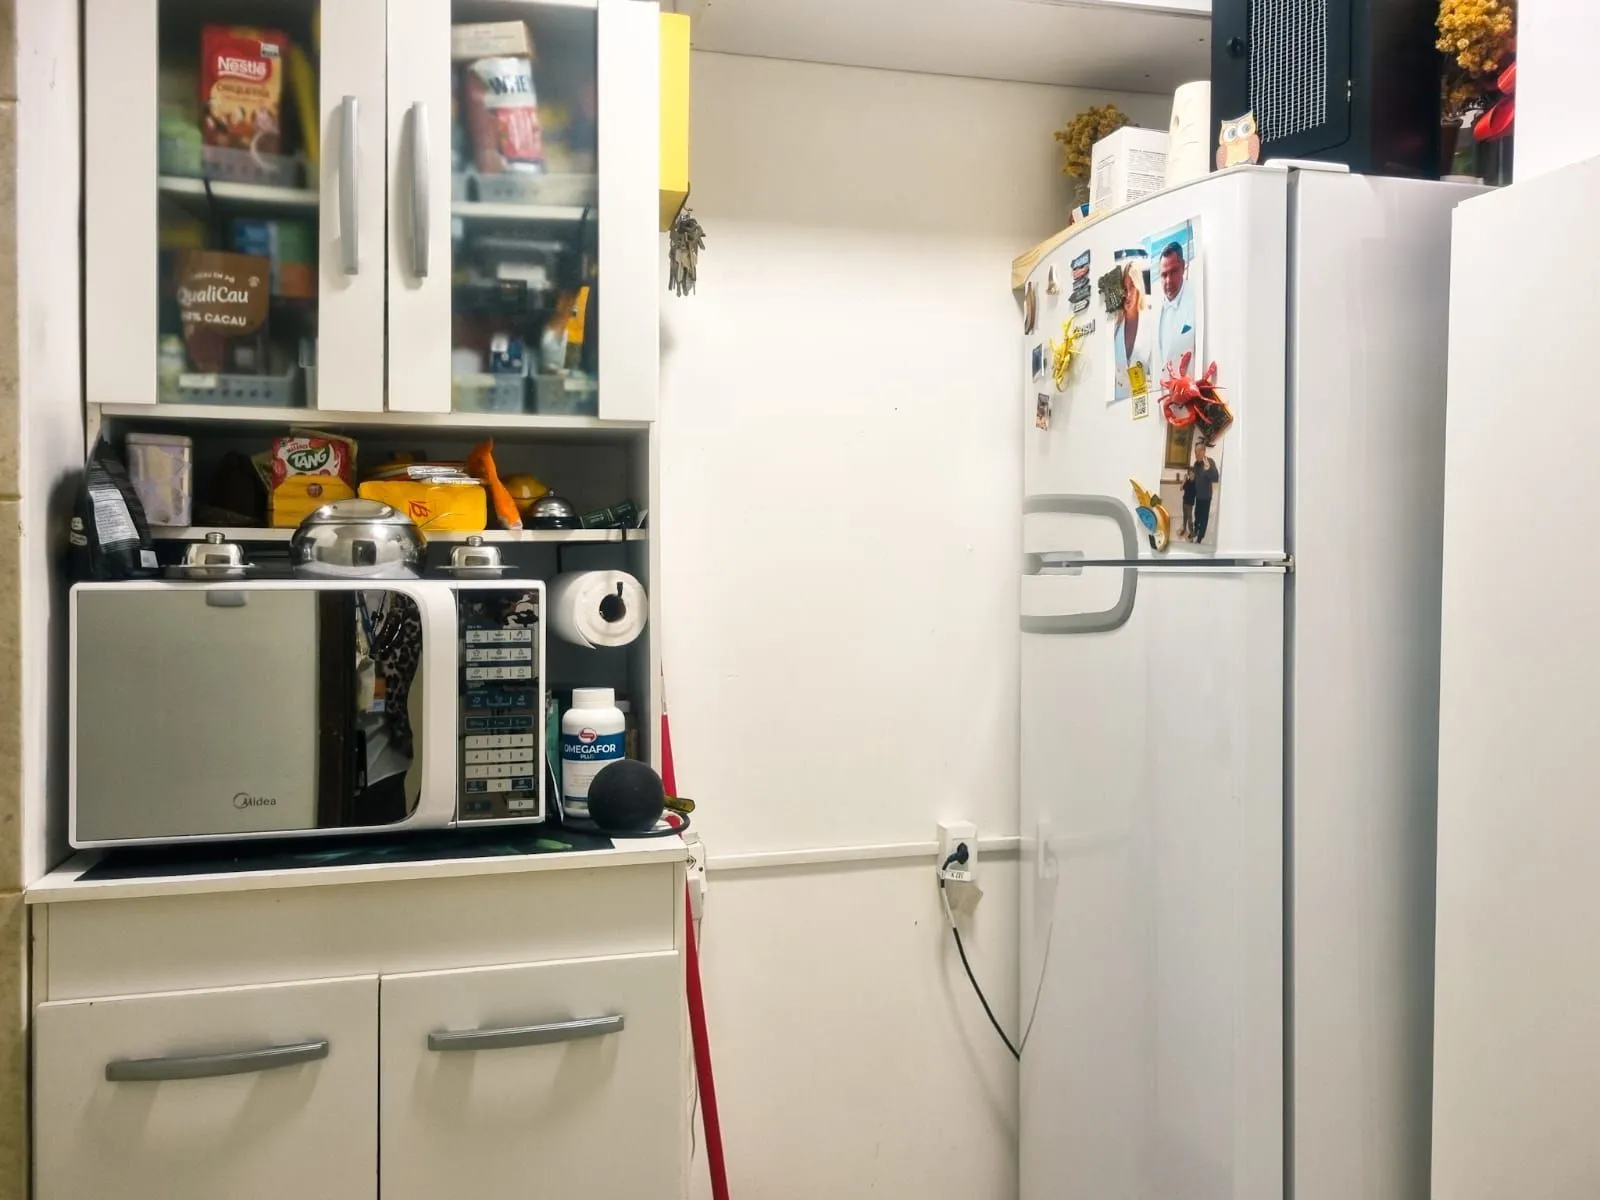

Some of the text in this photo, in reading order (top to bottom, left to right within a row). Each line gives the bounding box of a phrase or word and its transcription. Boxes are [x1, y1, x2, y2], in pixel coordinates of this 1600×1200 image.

[177, 284, 249, 307] QualiCau
[204, 312, 247, 327] CACAU
[291, 448, 328, 470] TANG
[564, 743, 616, 754] OMEGAFOR
[236, 795, 277, 808] Midea
